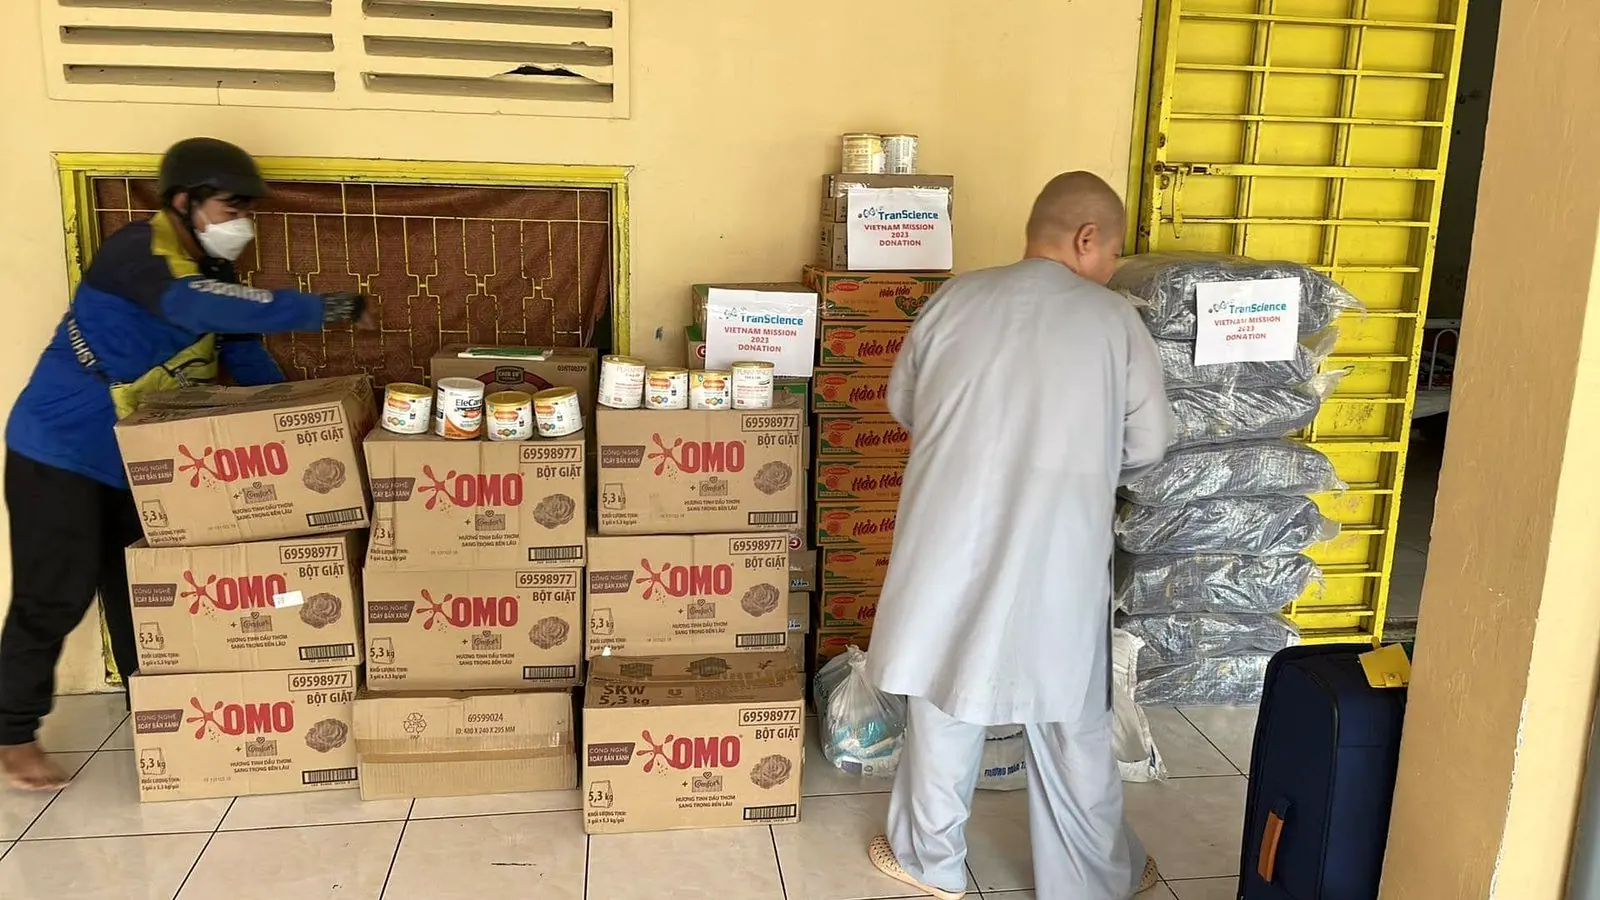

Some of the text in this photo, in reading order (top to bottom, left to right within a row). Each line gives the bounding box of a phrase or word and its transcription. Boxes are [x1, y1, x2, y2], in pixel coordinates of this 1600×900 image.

[878, 209, 938, 220] TranScience
[1229, 302, 1286, 314] TranScience
[740, 313, 804, 325] TranScience
[724, 326, 797, 336] VIETNAM MISSION
[738, 344, 781, 352] DONATION
[884, 336, 903, 353] Hả
[279, 410, 335, 428] 69598977
[745, 416, 795, 428] 69598977
[297, 428, 344, 448] BỘT GIẶT
[757, 432, 798, 448] BỘT GIẶT
[855, 433, 882, 448] Hảo
[523, 447, 577, 460] 69598977
[681, 440, 744, 474] OMO
[214, 442, 288, 482] OMO
[536, 466, 581, 480] BỘT GIẶT
[852, 474, 878, 491] Hảo
[454, 473, 523, 507] OMO
[602, 492, 616, 504] 5,3
[142, 510, 157, 522] 5,3
[852, 515, 895, 536] Hảo Hả
[374, 528, 385, 540] 5,3
[733, 540, 782, 551] 69598977
[284, 546, 338, 560] 69598977
[745, 556, 786, 571] BỘT GIẶT
[299, 564, 344, 580] BỘT GIẶT
[519, 573, 572, 585] 69598977
[669, 564, 732, 597] OMO
[216, 574, 286, 611] OMO
[532, 591, 576, 604] BỘT GIẶT
[451, 596, 518, 628] OMO
[857, 603, 877, 621] Hả
[590, 618, 604, 629] 5,3
[139, 632, 153, 644] 5,3
[370, 648, 384, 658] 5,3
[293, 674, 347, 688] 69598977
[603, 685, 645, 695] SKW
[307, 692, 352, 707] BỘT GIẶT
[599, 695, 649, 706] 5,3 kg
[223, 701, 294, 736] OMO
[468, 712, 503, 722] 69599024
[743, 710, 796, 722] 69598977
[755, 727, 799, 742] BỘT GIẶT
[672, 736, 740, 770] OMO
[140, 758, 154, 769] 5,3
[589, 790, 603, 803] 5,3
